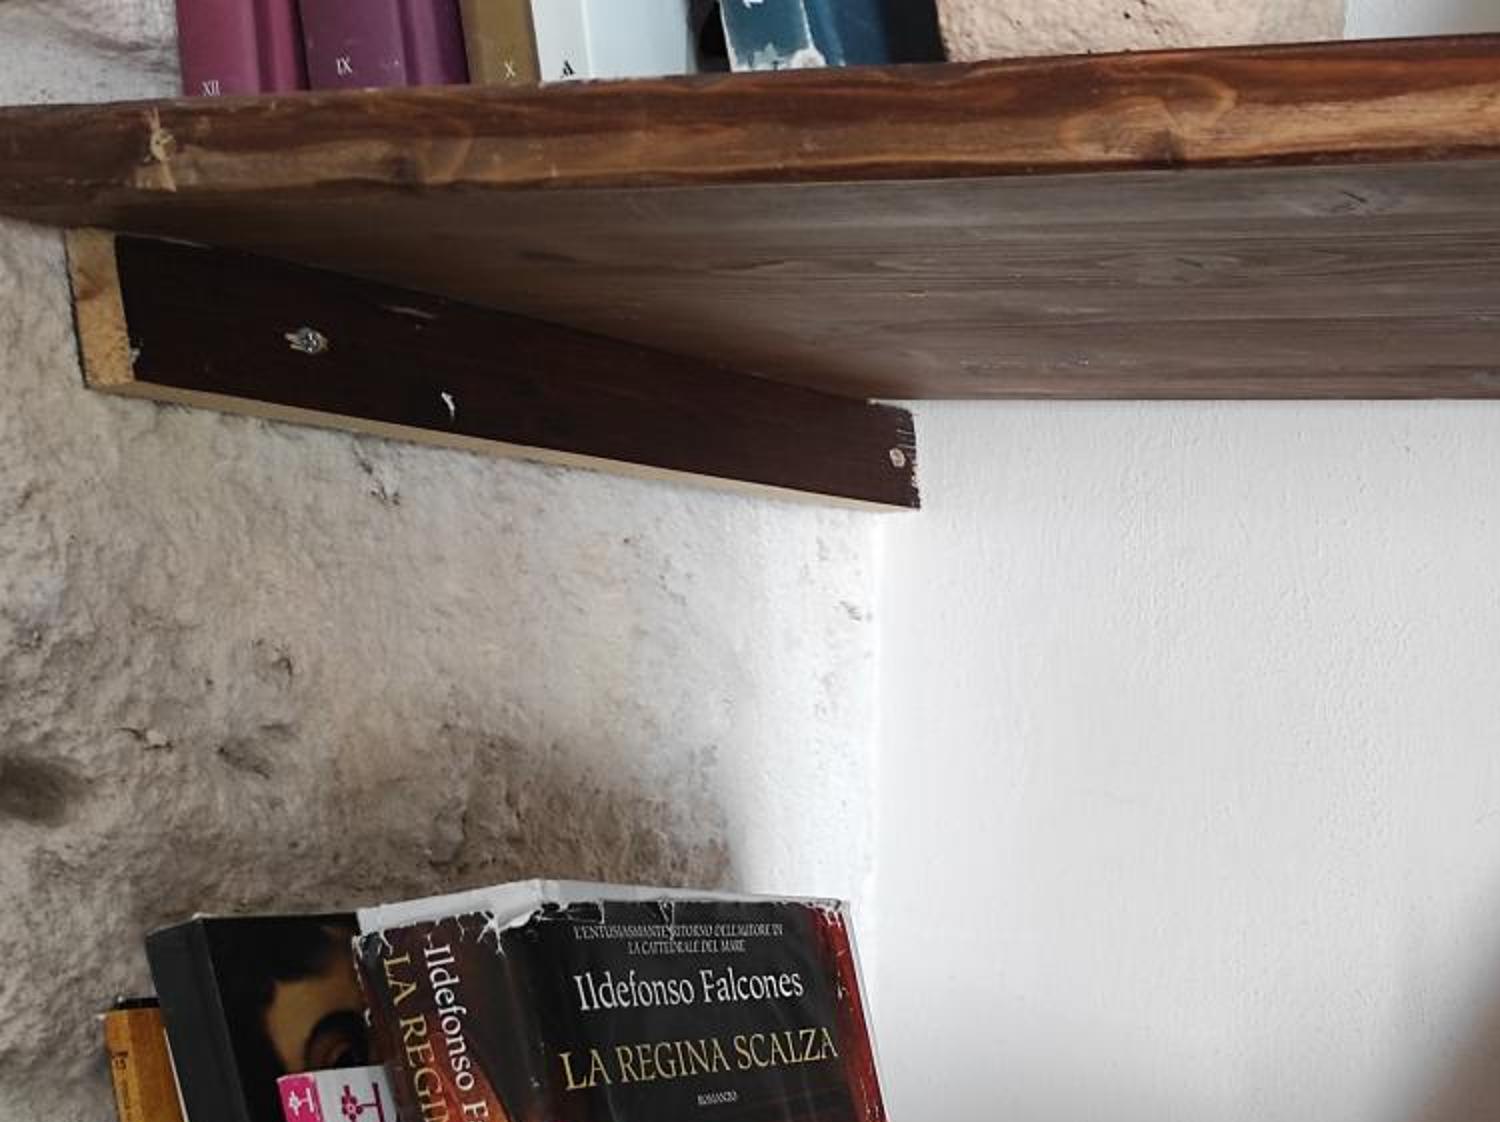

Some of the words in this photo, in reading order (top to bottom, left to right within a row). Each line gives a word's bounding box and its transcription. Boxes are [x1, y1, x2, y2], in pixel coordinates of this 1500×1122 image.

[336, 56, 353, 75] IX
[503, 60, 516, 79] X
[383, 954, 418, 1006] LA
[573, 969, 696, 1010] Ildefonso
[700, 967, 805, 1003] Falcones
[423, 943, 475, 1092] Ildefonso
[560, 1049, 613, 1091] LA
[615, 1038, 732, 1083] REGINA
[733, 1026, 840, 1070] SCALZA
